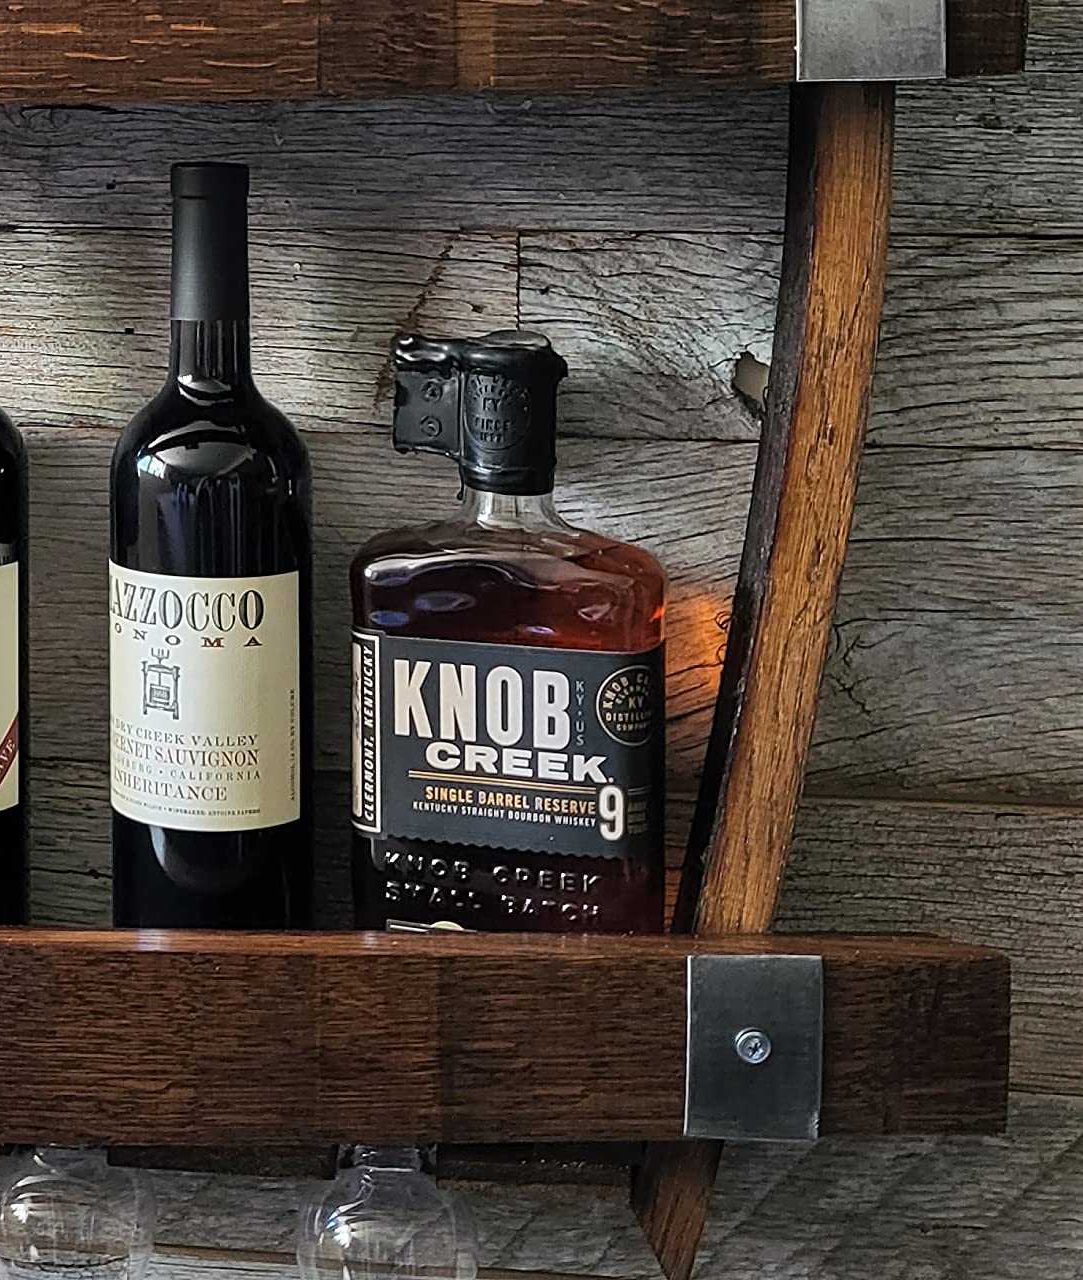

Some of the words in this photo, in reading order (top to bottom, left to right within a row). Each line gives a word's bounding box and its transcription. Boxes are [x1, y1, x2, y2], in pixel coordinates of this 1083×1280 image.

[114, 622, 263, 647] ONOMA
[362, 645, 374, 728] KENTUCKY
[602, 676, 630, 709] KNOB
[393, 658, 572, 751] KNOB
[135, 727, 185, 745] CREEK
[191, 734, 259, 747] VALLEY
[155, 746, 261, 767] SAUVIGNON
[170, 768, 261, 781] CALIFORNIA
[413, 800, 458, 814] KENTUCKY
[461, 805, 505, 819] STRAIGHT
[507, 810, 551, 824] BOURBON
[554, 815, 597, 828] WHISKEY
[425, 786, 474, 804] SINGLE
[478, 790, 530, 809] BARREL
[534, 796, 596, 815] RESERVE
[599, 784, 624, 841] 9
